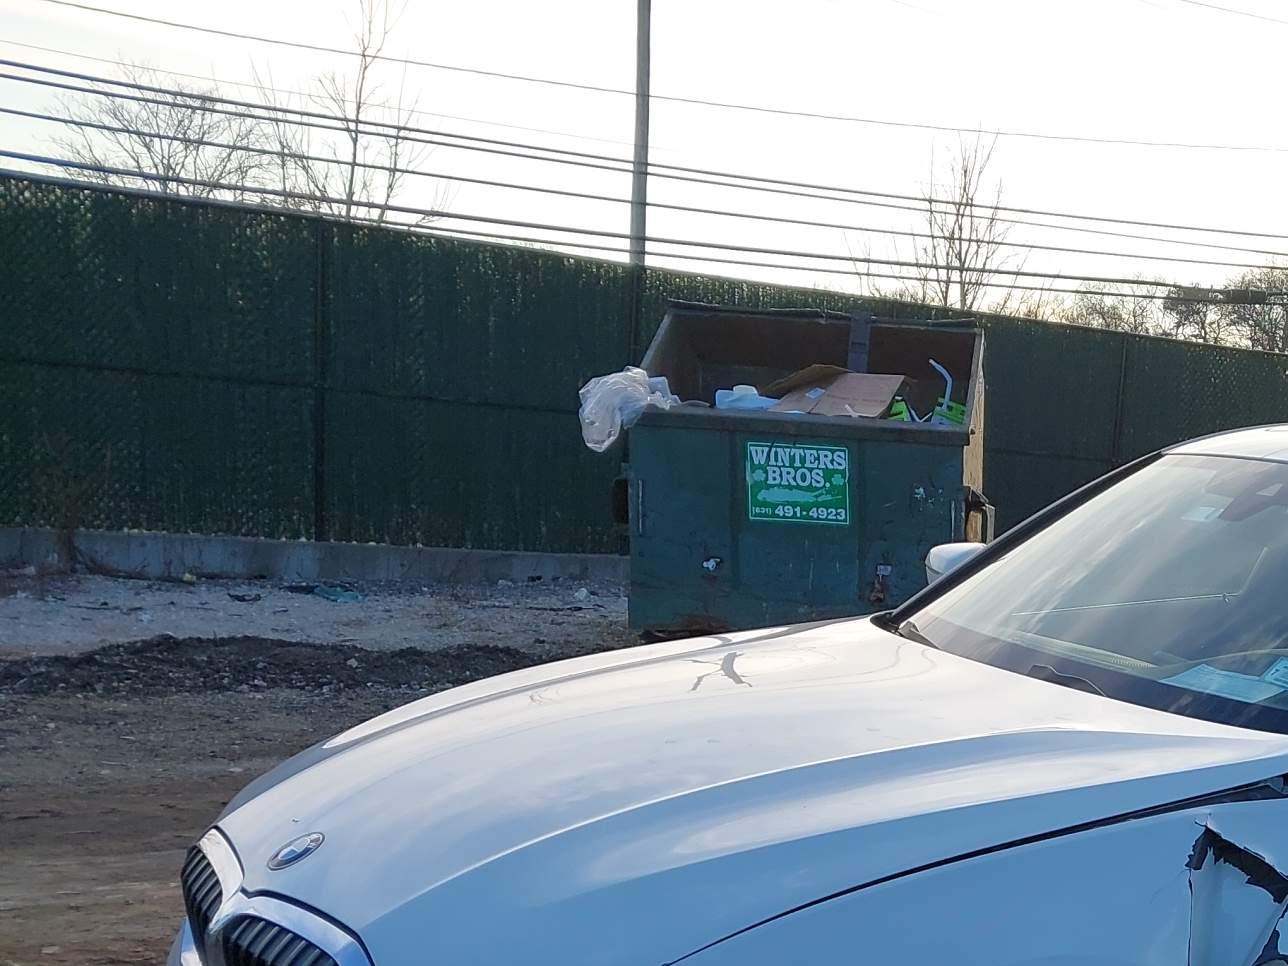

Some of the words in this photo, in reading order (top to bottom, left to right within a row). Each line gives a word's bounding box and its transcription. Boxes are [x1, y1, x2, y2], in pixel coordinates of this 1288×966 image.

[750, 446, 846, 470] WINTERS
[766, 466, 831, 488] BROS.
[774, 505, 846, 520] 491-4923
